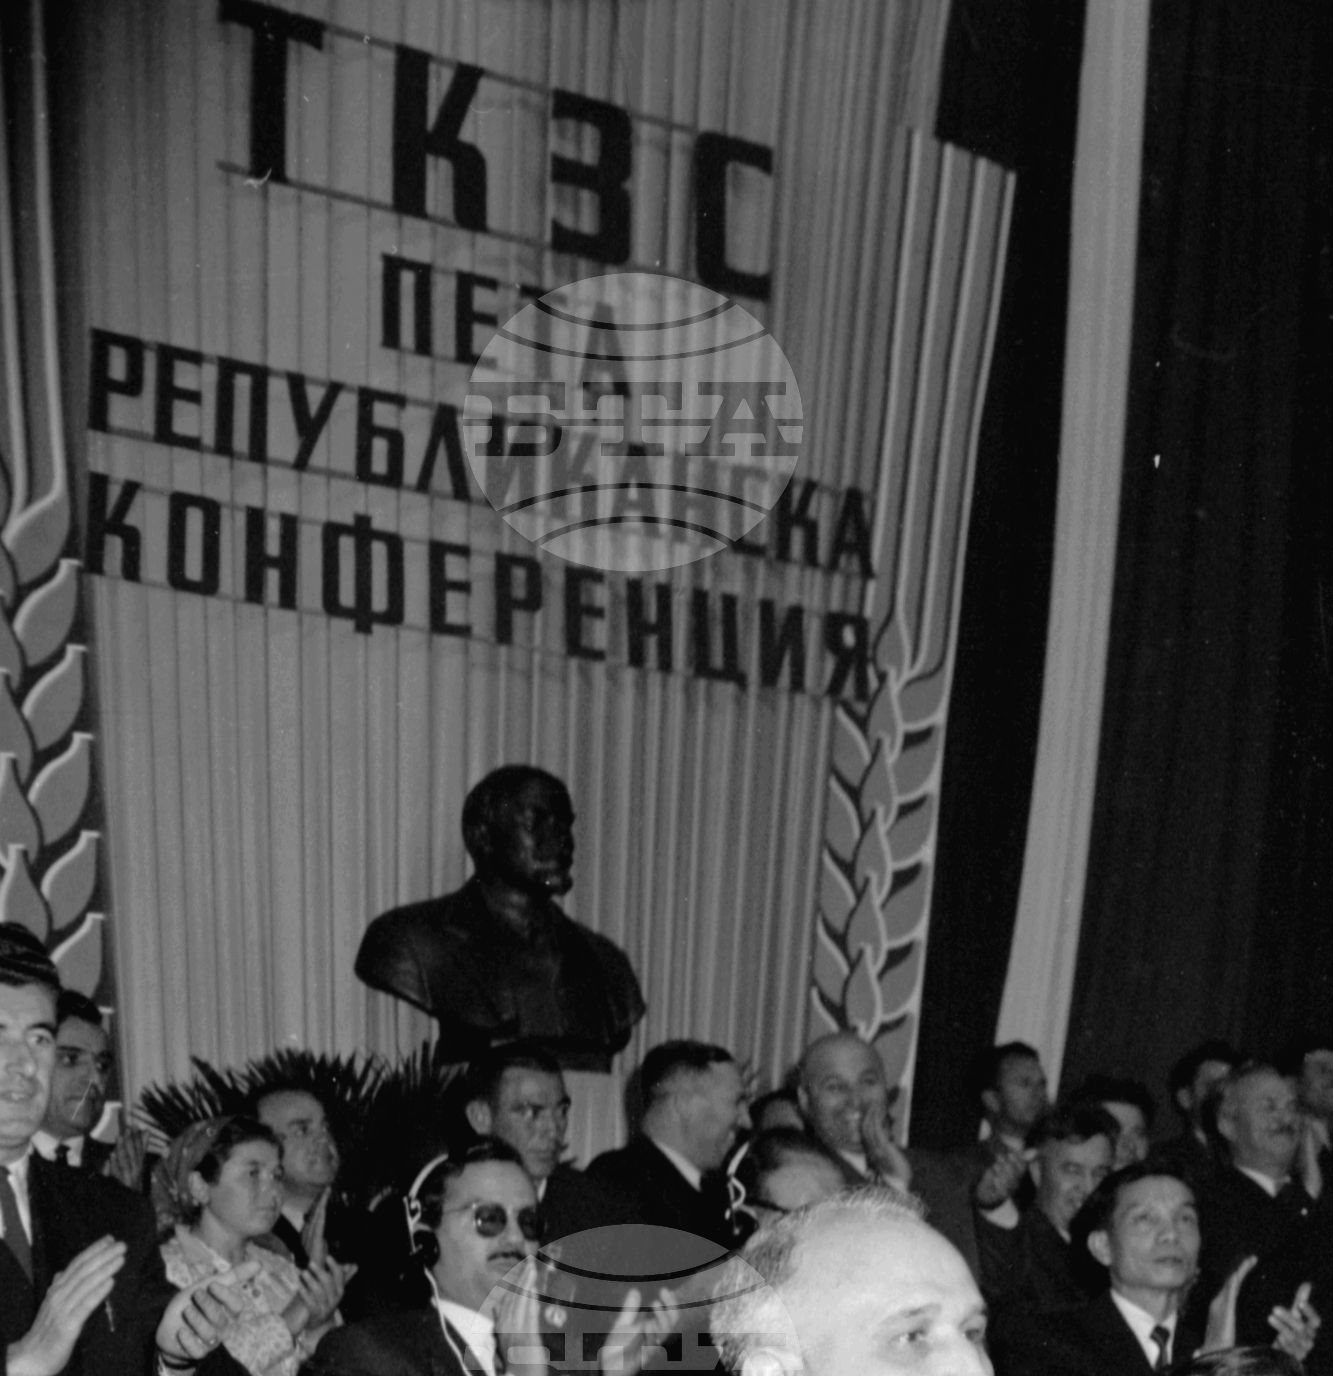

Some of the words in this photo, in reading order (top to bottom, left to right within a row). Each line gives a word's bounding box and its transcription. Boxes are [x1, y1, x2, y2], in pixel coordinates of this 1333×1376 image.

[219, 0, 774, 302] ТКЗС
[88, 326, 875, 581] РЕПУБЛИКАНСКА
[82, 470, 872, 704] КОНФЕРЕНЦИЯ
